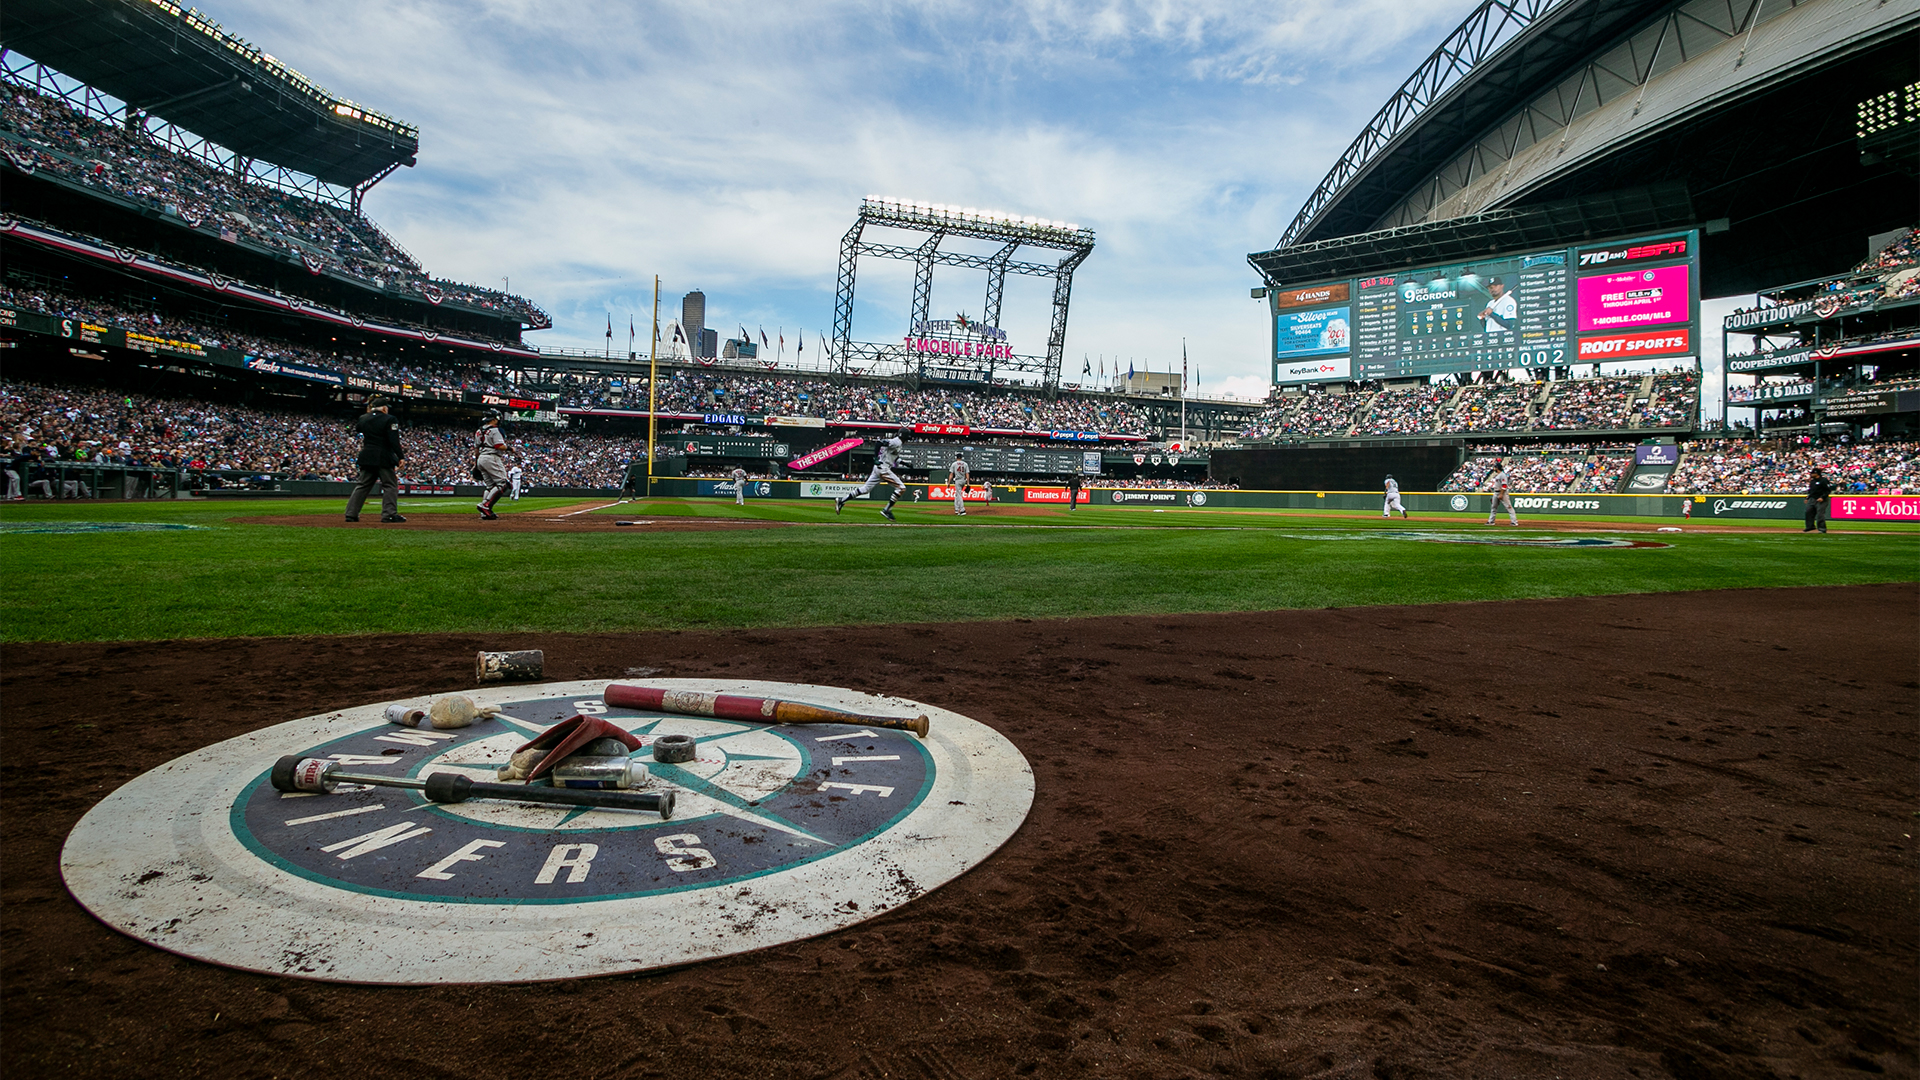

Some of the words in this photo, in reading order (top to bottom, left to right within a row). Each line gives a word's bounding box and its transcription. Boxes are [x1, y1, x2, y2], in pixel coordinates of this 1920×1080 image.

[1579, 251, 1609, 266] 710
[1627, 241, 1686, 259] ESPN
[1361, 278, 1376, 289] RED
[1379, 277, 1395, 286] SOX
[1305, 290, 1330, 299] HANDS
[1404, 290, 1416, 303] 9
[1416, 291, 1456, 302] GORDON
[1601, 293, 1624, 302] FREE
[1603, 300, 1632, 308] THROUGH
[1298, 312, 1327, 323] Silver
[1593, 311, 1671, 325] T-MOBILE.COM/MLB
[1725, 302, 1813, 329] COUNTDOWN
[915, 320, 951, 333] SEATTLE
[970, 321, 1007, 340] MARINERS
[1290, 323, 1322, 331] SILVERSEATS
[904, 337, 971, 356] T-MOBILE
[976, 344, 1014, 359] PARK
[1580, 339, 1626, 354] ROOT
[1626, 337, 1683, 350] SPORTS
[1520, 352, 1531, 366] 0
[1537, 351, 1547, 364] 0
[1553, 350, 1564, 363] 2
[1730, 351, 1810, 371] COOPERSTOWN
[249, 358, 280, 373] Alaska
[1290, 367, 1319, 375] KeyBank
[932, 368, 948, 379] TRUE
[948, 370, 957, 380] TO
[957, 370, 969, 380] THE
[969, 370, 985, 381] BLUE
[347, 376, 356, 386] 94
[356, 378, 372, 388] MPH
[1755, 386, 1783, 399] 115
[1784, 383, 1813, 396] DAYS
[482, 395, 500, 404] 710
[509, 398, 540, 410] ESPN
[704, 414, 745, 424] EDGARS
[946, 426, 964, 434] xfinity
[797, 456, 813, 468] THE
[713, 482, 737, 490] Alask
[1028, 491, 1059, 499] Emirates
[1514, 498, 1552, 509] ROOT
[1552, 501, 1600, 509] SPORTS
[1731, 501, 1787, 509] BOEING
[1875, 501, 1920, 515] Mobi
